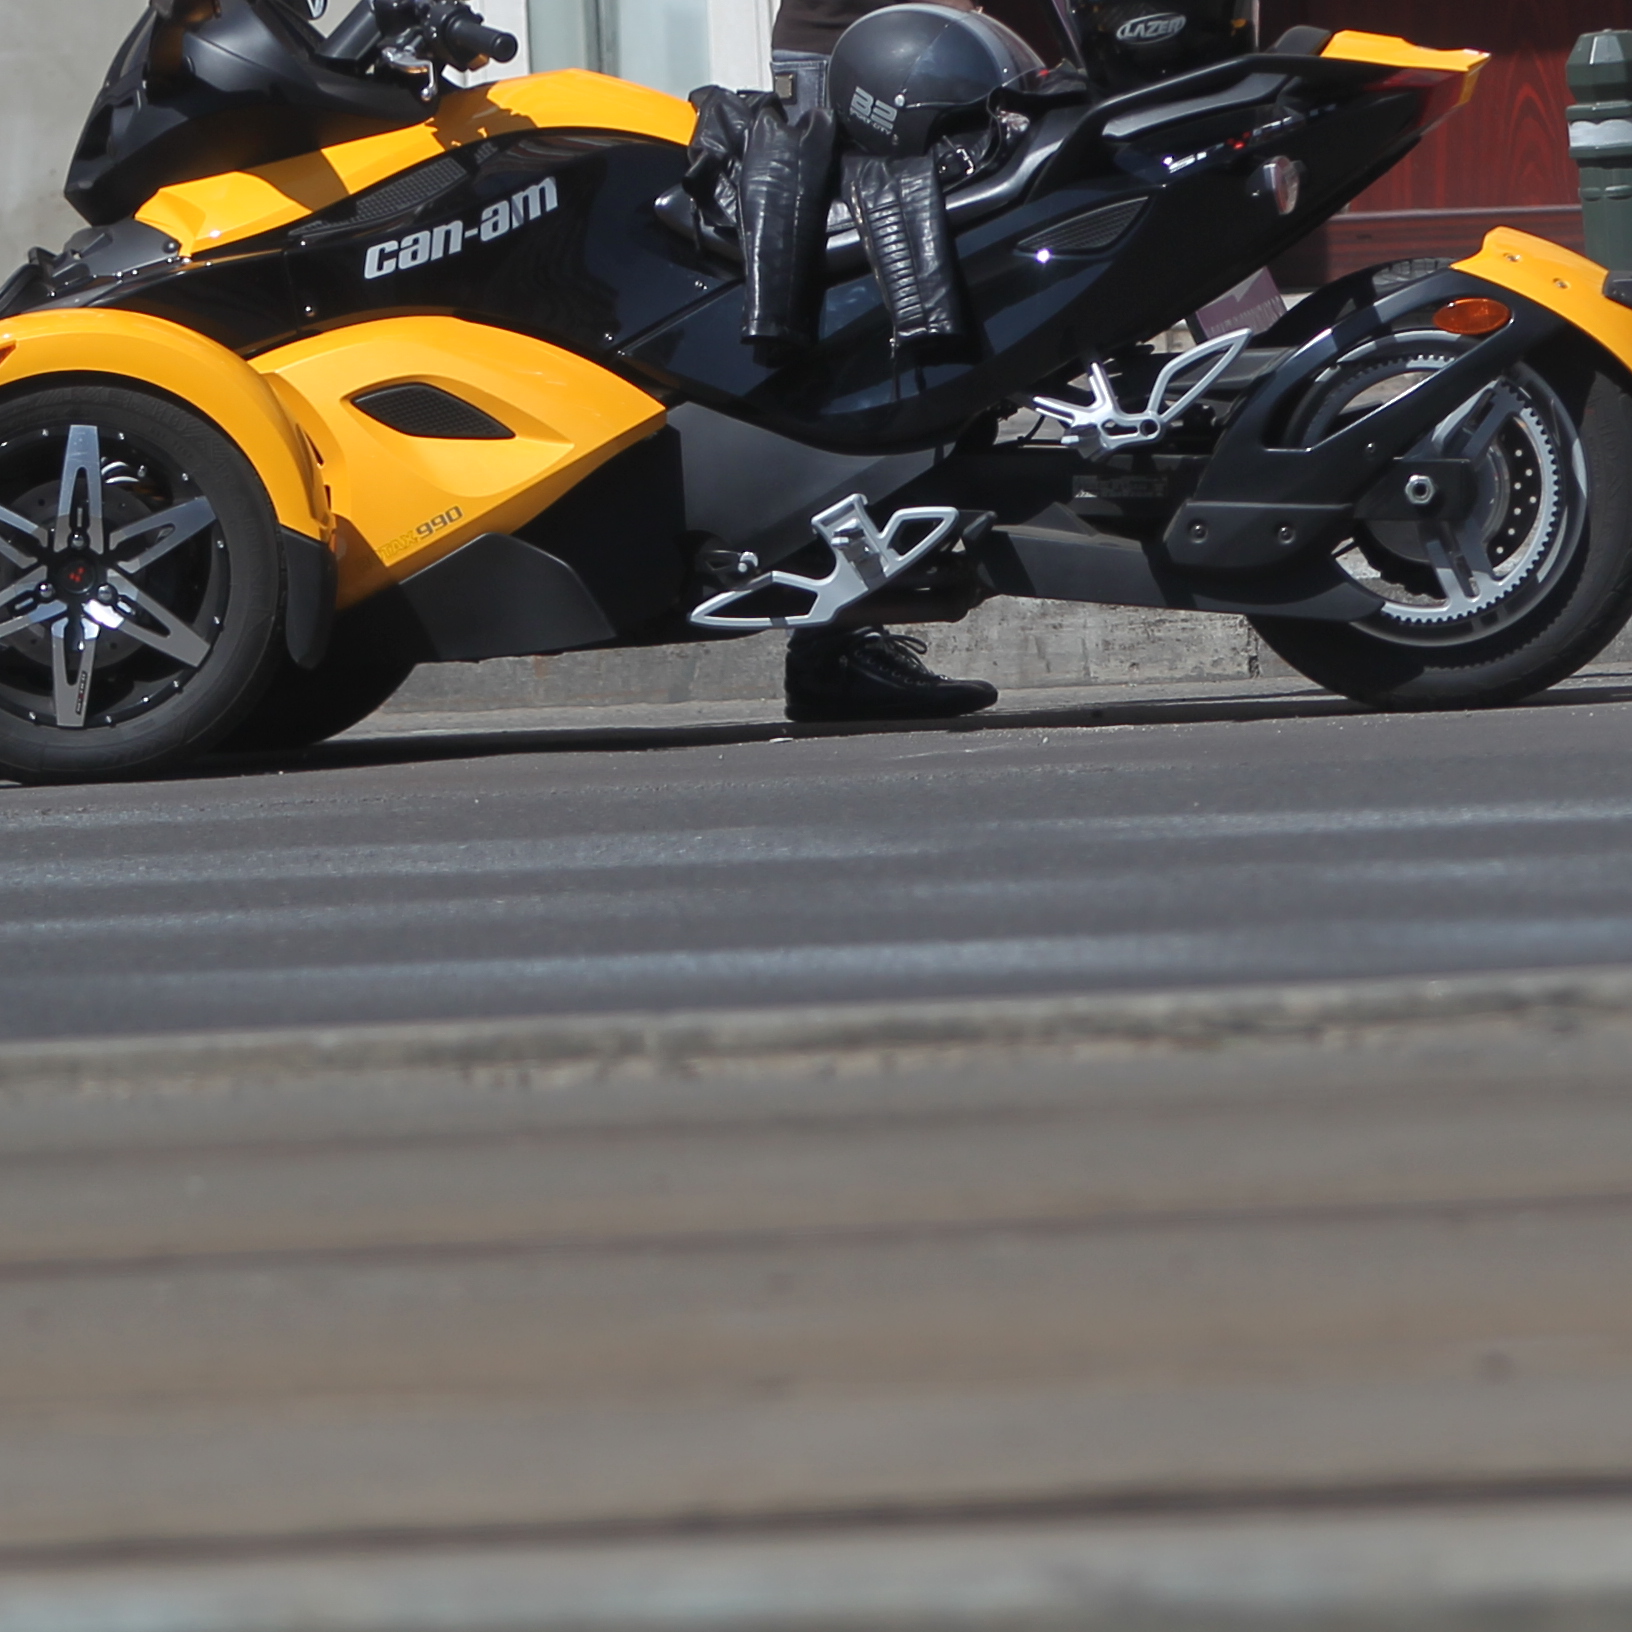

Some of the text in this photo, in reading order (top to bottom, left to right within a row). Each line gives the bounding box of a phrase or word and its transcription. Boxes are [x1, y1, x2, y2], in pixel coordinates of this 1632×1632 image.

[1116, 14, 1187, 40] LAZER
[364, 176, 559, 280] can-am
[415, 504, 464, 541] 990
